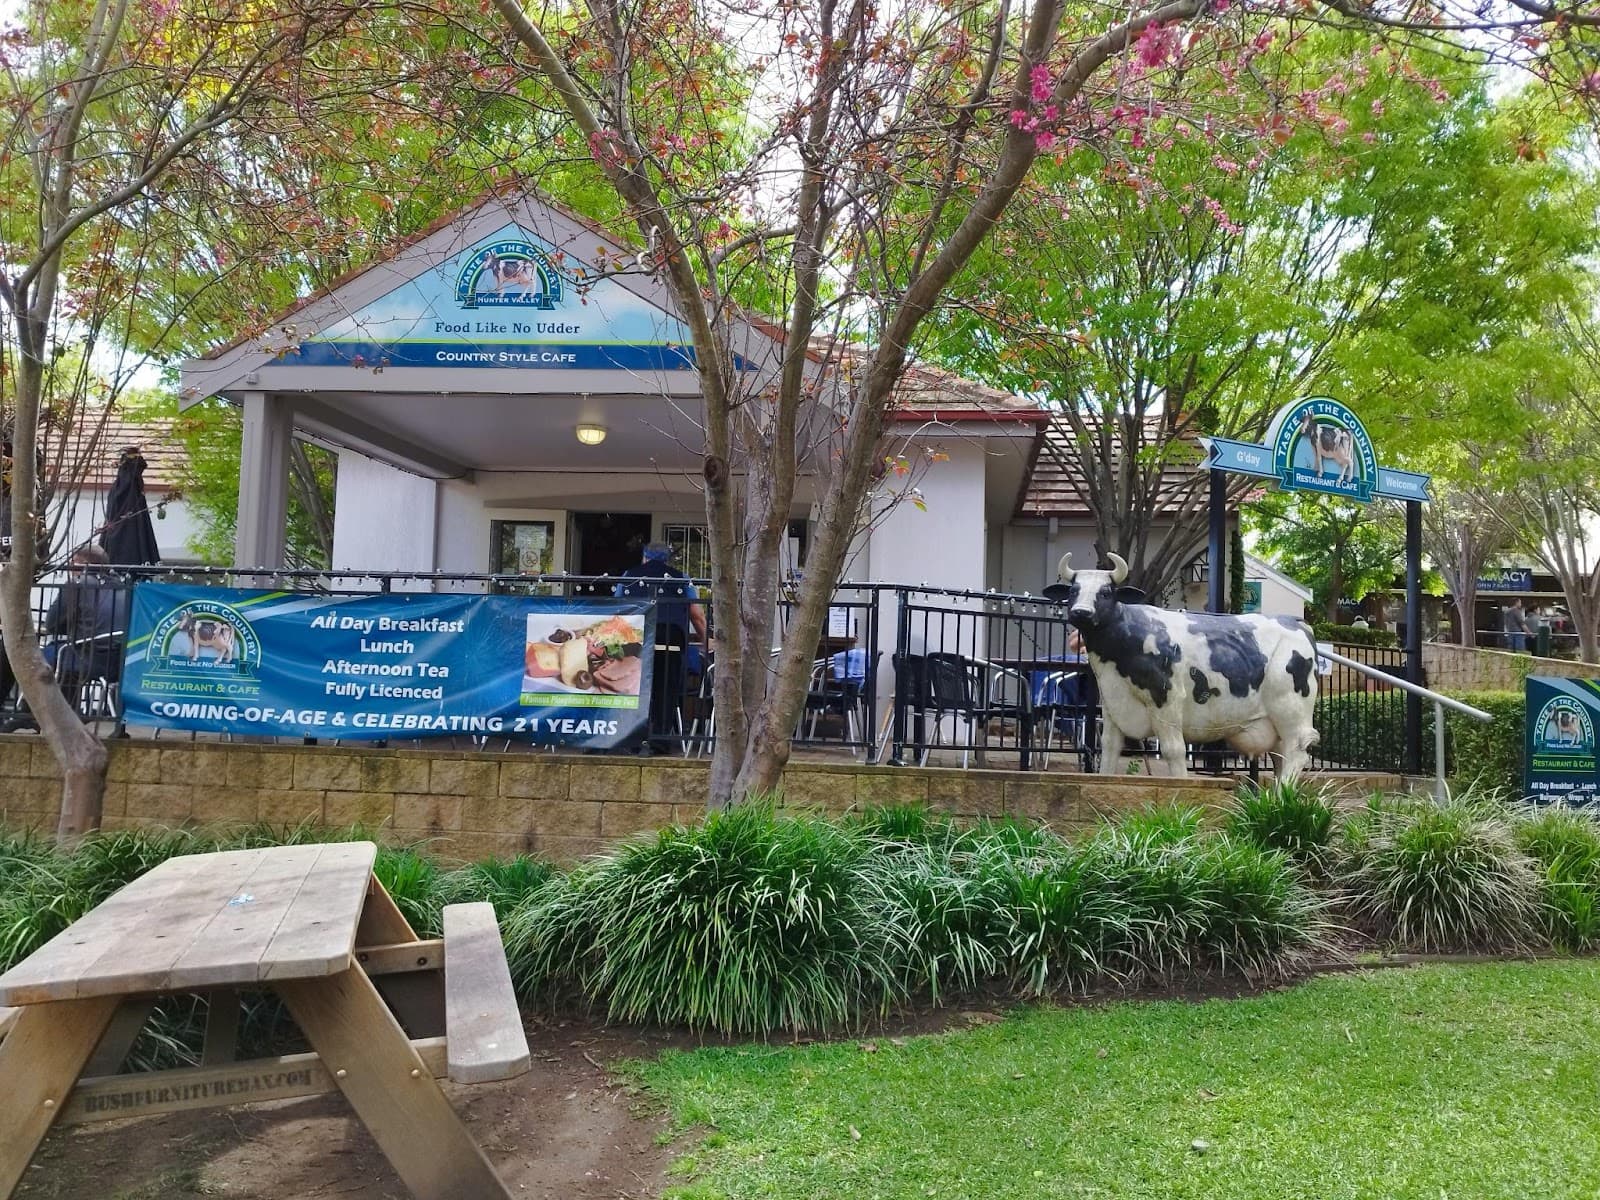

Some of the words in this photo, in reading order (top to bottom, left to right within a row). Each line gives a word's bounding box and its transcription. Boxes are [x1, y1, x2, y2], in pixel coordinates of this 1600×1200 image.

[460, 257, 482, 288] TASTE
[435, 322, 470, 333] Food
[476, 322, 507, 333] Like
[512, 322, 531, 334] No
[537, 323, 581, 334] Udder
[436, 351, 495, 362] COUNTRY
[499, 352, 538, 362] STYLE
[541, 352, 577, 363] CAFE
[1278, 416, 1301, 457] TASTE
[1302, 405, 1314, 416] OF
[1318, 403, 1339, 415] THE
[1342, 412, 1374, 474] COUNTRY
[1236, 451, 1261, 467] G'day
[1296, 473, 1336, 487] RESTAURANT
[1341, 481, 1358, 491] CAFE
[1385, 475, 1418, 490] Welcome
[153, 616, 178, 649] TASTE
[180, 606, 192, 616] OF
[196, 604, 218, 613] THE
[221, 609, 256, 655] COUNTRY
[311, 613, 337, 629] All
[340, 616, 375, 634] Day
[379, 616, 464, 633] Breakfast
[360, 639, 414, 654] Lunch
[322, 660, 412, 677] Afternoon
[418, 663, 449, 678] Tea
[141, 680, 214, 692] RESTAURANT
[216, 683, 225, 693] &
[228, 684, 260, 695] CAFE
[326, 682, 366, 700] Fully
[370, 683, 443, 699] Licenced
[150, 701, 327, 725] COMING-OF-AGE
[331, 712, 346, 727] &
[352, 712, 503, 732] CELEBRATING
[513, 718, 538, 733] 21
[546, 718, 618, 735] YEARS
[1536, 709, 1549, 735] TASTE
[1573, 702, 1592, 738] COUNTRY
[1532, 760, 1571, 768] RESTAURANT
[1539, 782, 1549, 790] Day
